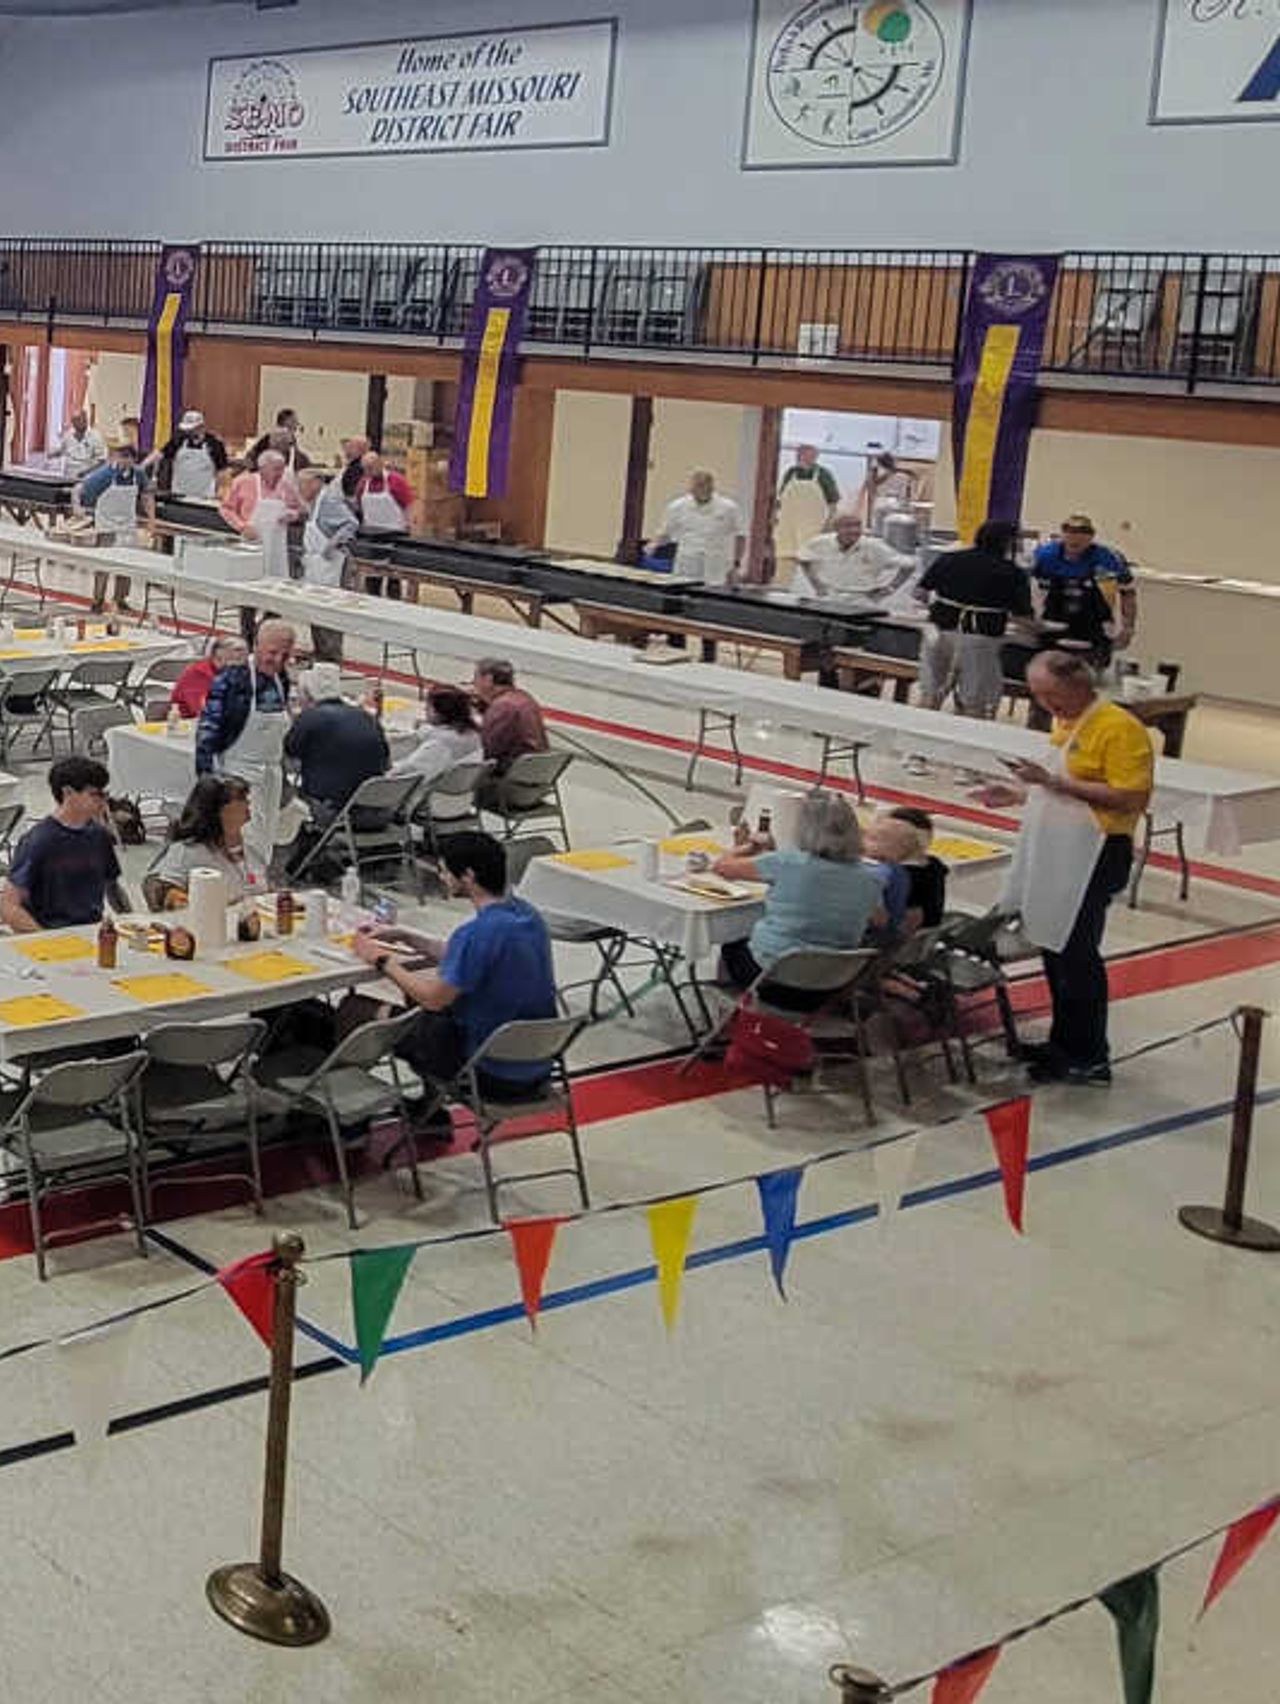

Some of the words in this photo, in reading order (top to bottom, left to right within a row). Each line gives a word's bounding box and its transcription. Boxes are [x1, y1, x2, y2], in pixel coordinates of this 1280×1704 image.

[397, 47, 455, 74] Home
[459, 43, 487, 68] of
[487, 39, 523, 66] the
[344, 81, 460, 115] SOUTHEAST
[466, 71, 581, 105] MISSOURI
[224, 102, 305, 131] SEMO
[370, 113, 467, 143] DISTRICT
[467, 110, 523, 139] FAIR
